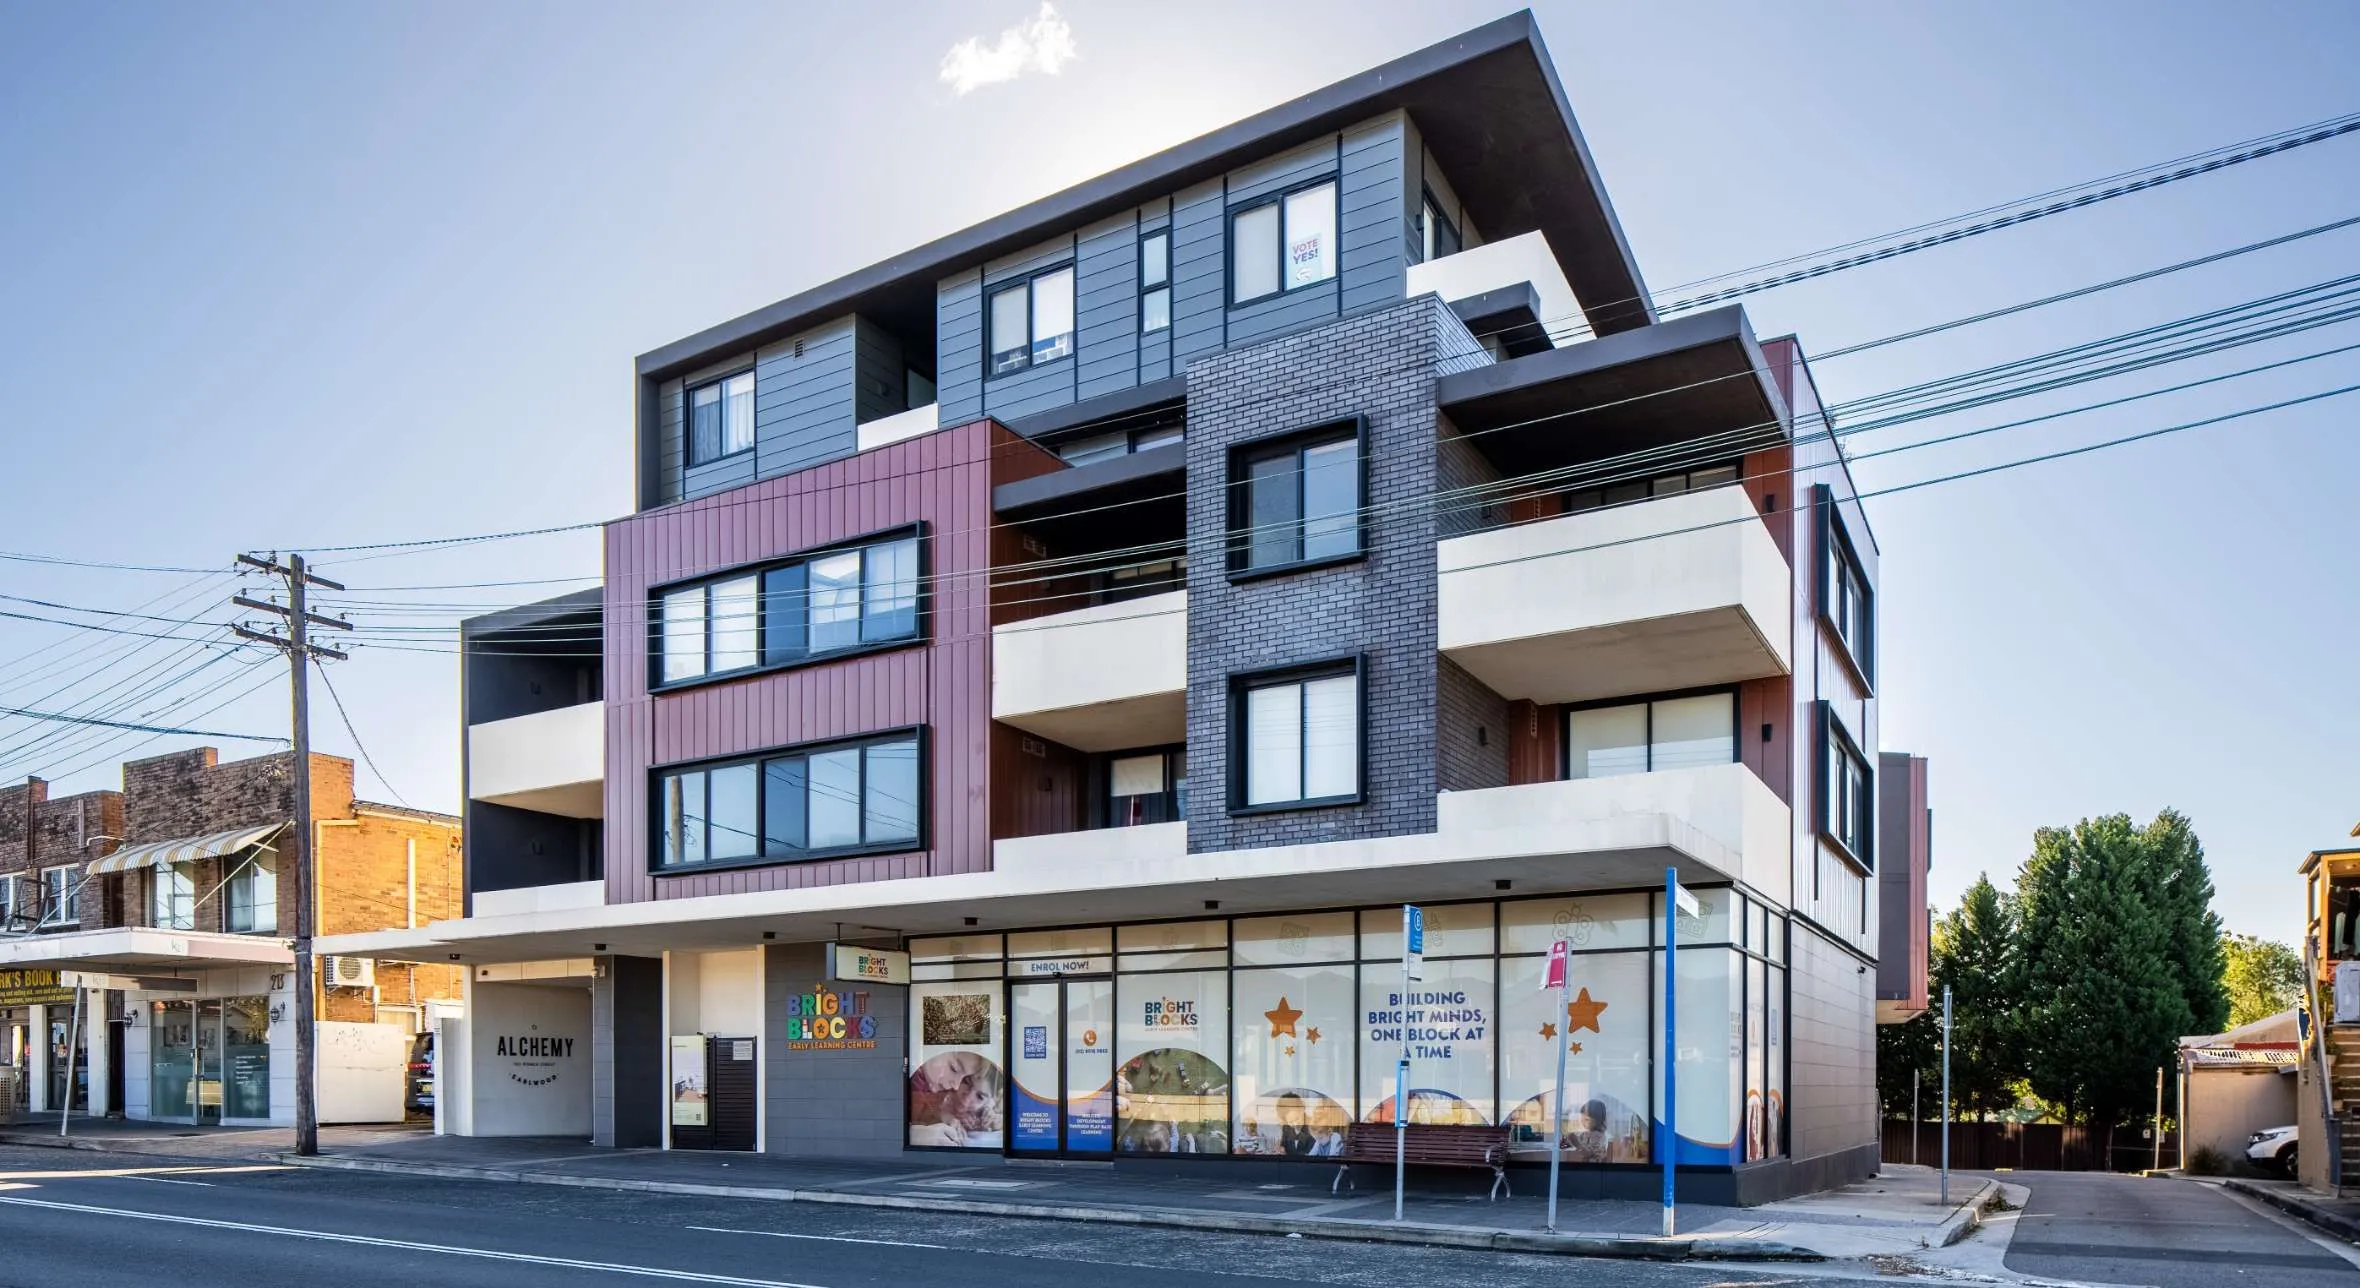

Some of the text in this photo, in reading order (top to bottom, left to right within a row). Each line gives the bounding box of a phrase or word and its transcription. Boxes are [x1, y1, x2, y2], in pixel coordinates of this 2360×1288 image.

[1292, 239, 1318, 254] VOTE
[1293, 249, 1318, 264] YES!
[858, 956, 887, 966] BRIGHT
[1031, 960, 1089, 972] ENROL NOW!
[858, 965, 889, 975] BLOCKS
[25, 970, 53, 987] BOOK
[270, 973, 285, 990] 213
[786, 990, 870, 1016] BRIGHT
[1389, 992, 1466, 1006] BUILDING
[1144, 1000, 1195, 1014] BRIGHT
[1144, 1014, 1199, 1026] BLOCKS
[1368, 1009, 1487, 1025] BRIGHT MINDS,
[786, 1016, 877, 1040] BLOCKS
[1371, 1027, 1484, 1041] ONE BLOCK AT
[497, 1035, 574, 1057] ALCHEMY
[788, 1041, 876, 1050] EARLY LEARNING CENTRE
[1415, 1045, 1452, 1058] TIME
